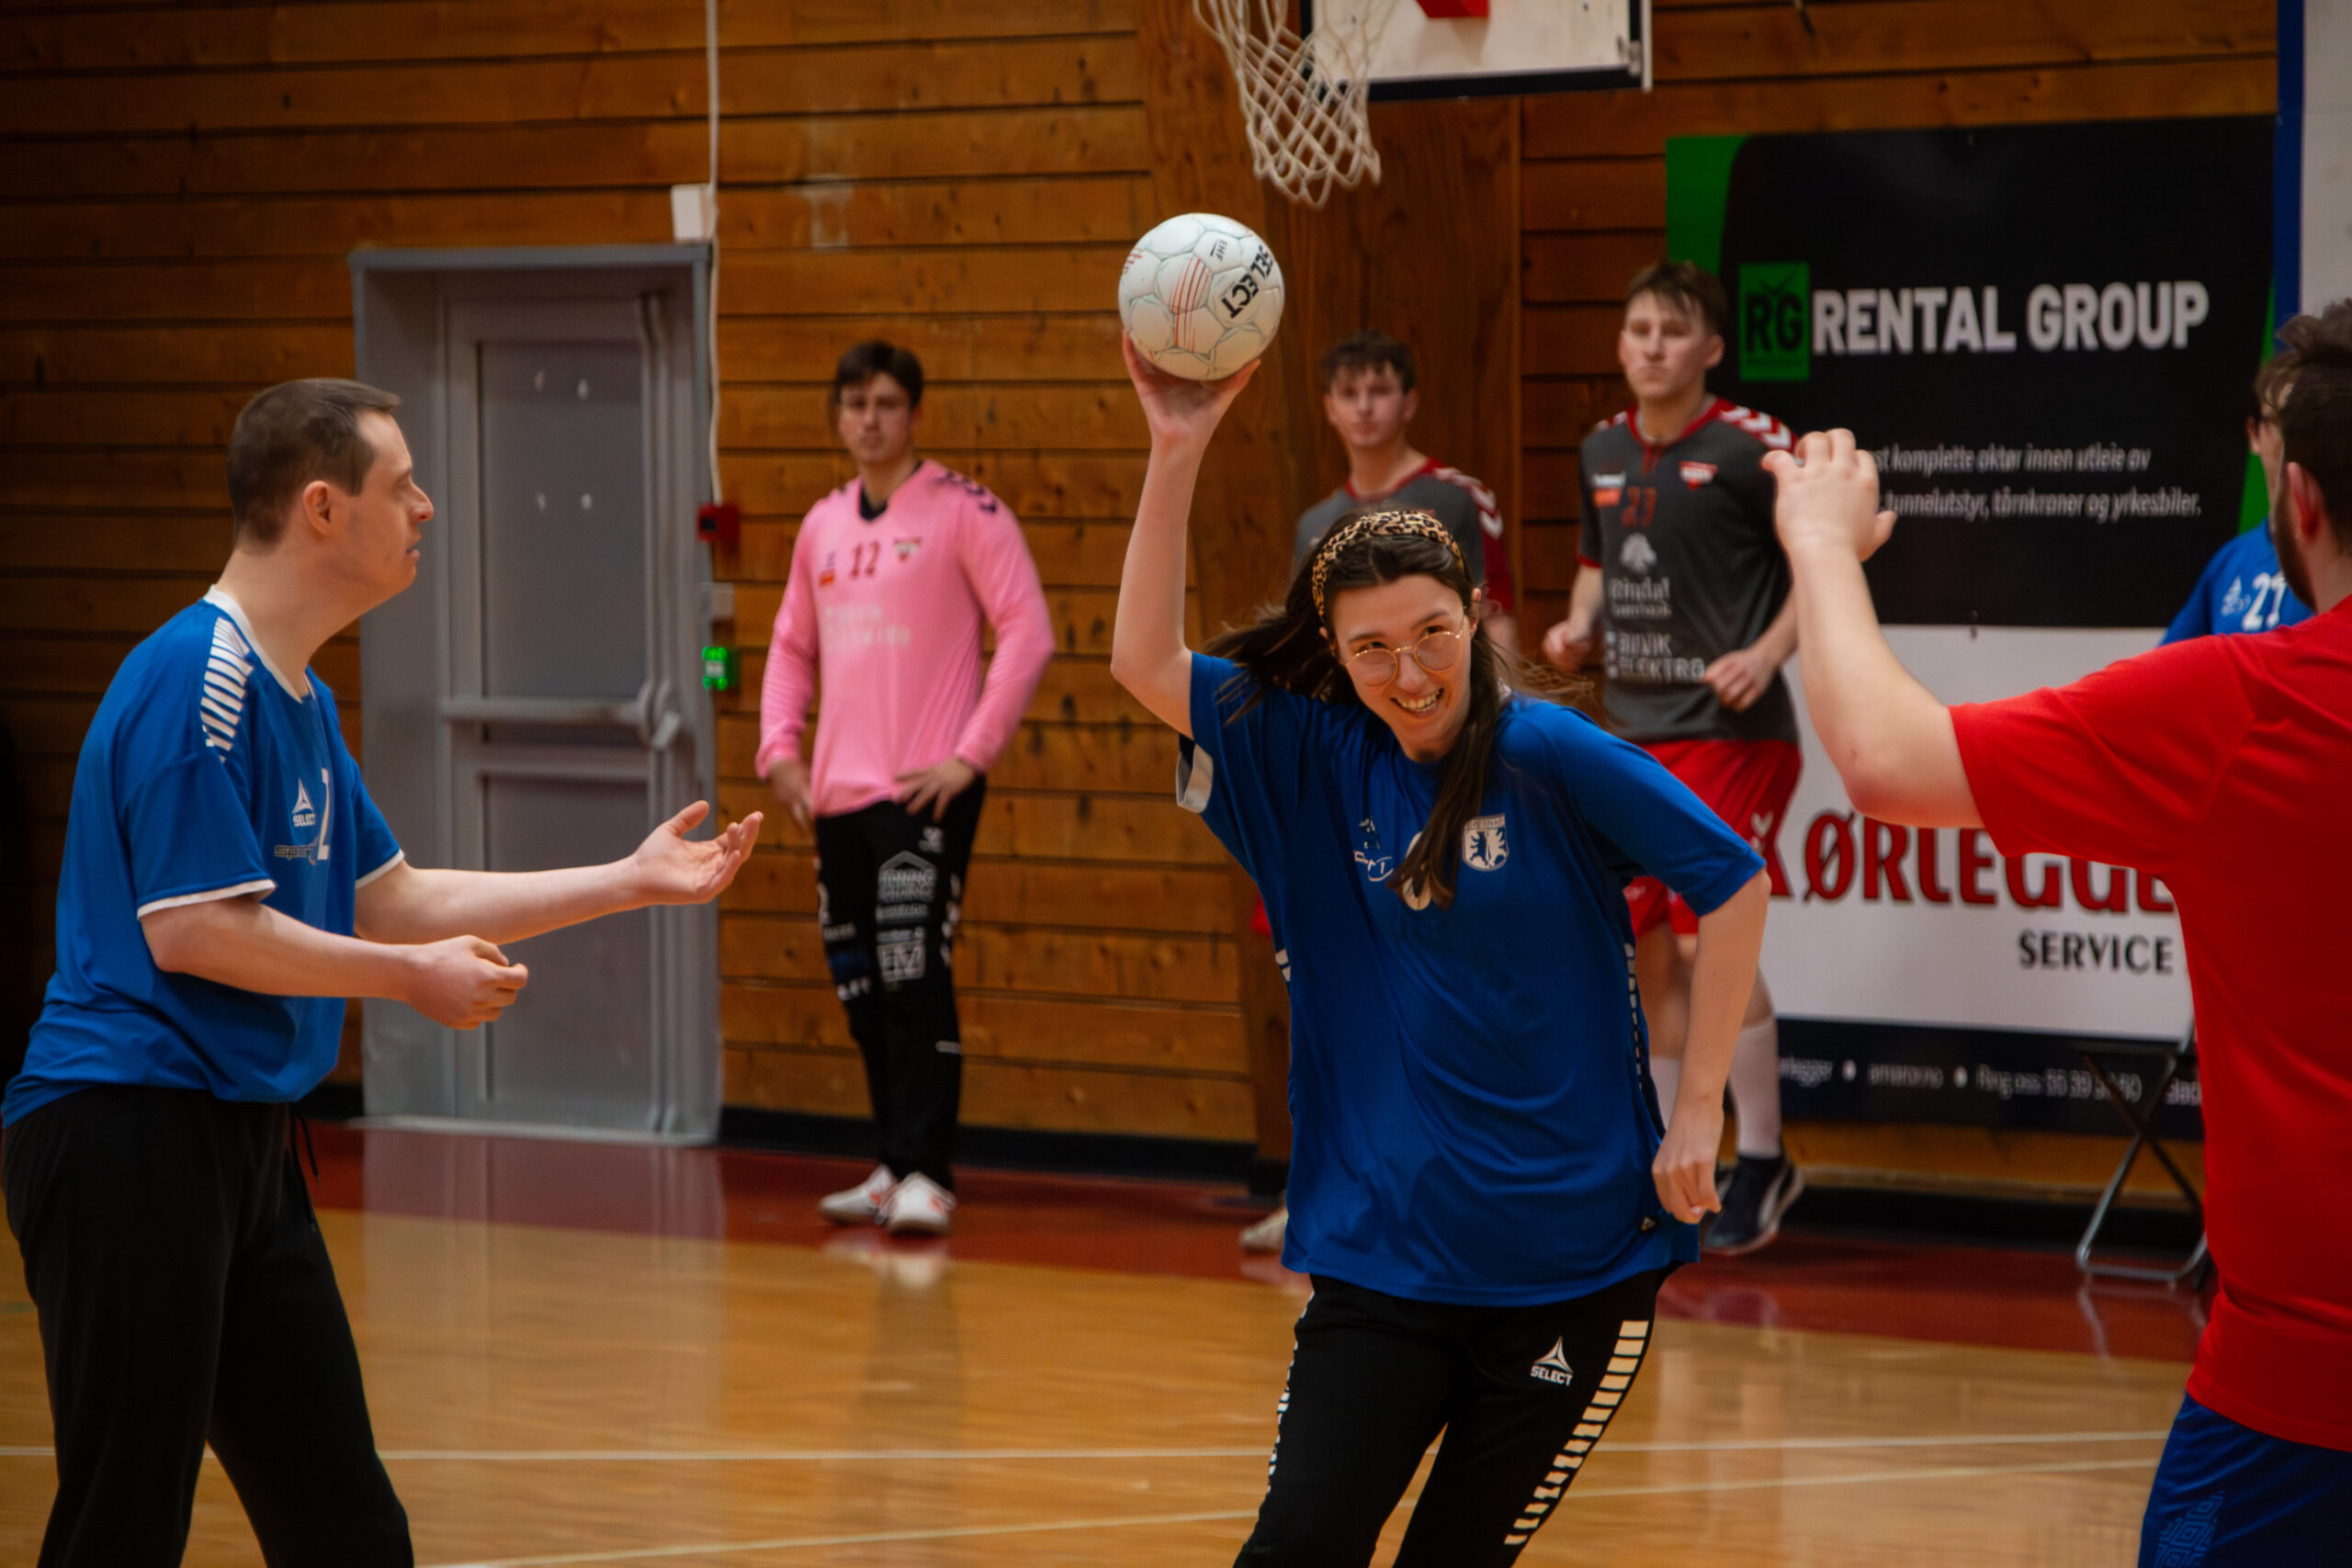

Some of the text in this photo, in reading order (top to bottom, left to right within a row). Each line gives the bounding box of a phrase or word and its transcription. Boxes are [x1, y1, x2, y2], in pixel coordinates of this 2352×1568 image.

[1221, 243, 1273, 319] SELECT
[1812, 279, 2210, 355] RENTAL GROUP
[293, 813, 315, 827] SELECT
[1770, 808, 2176, 913] ØRLEGGE
[2018, 929, 2174, 974] SERVICE
[1530, 1364, 1573, 1387] SELECT
